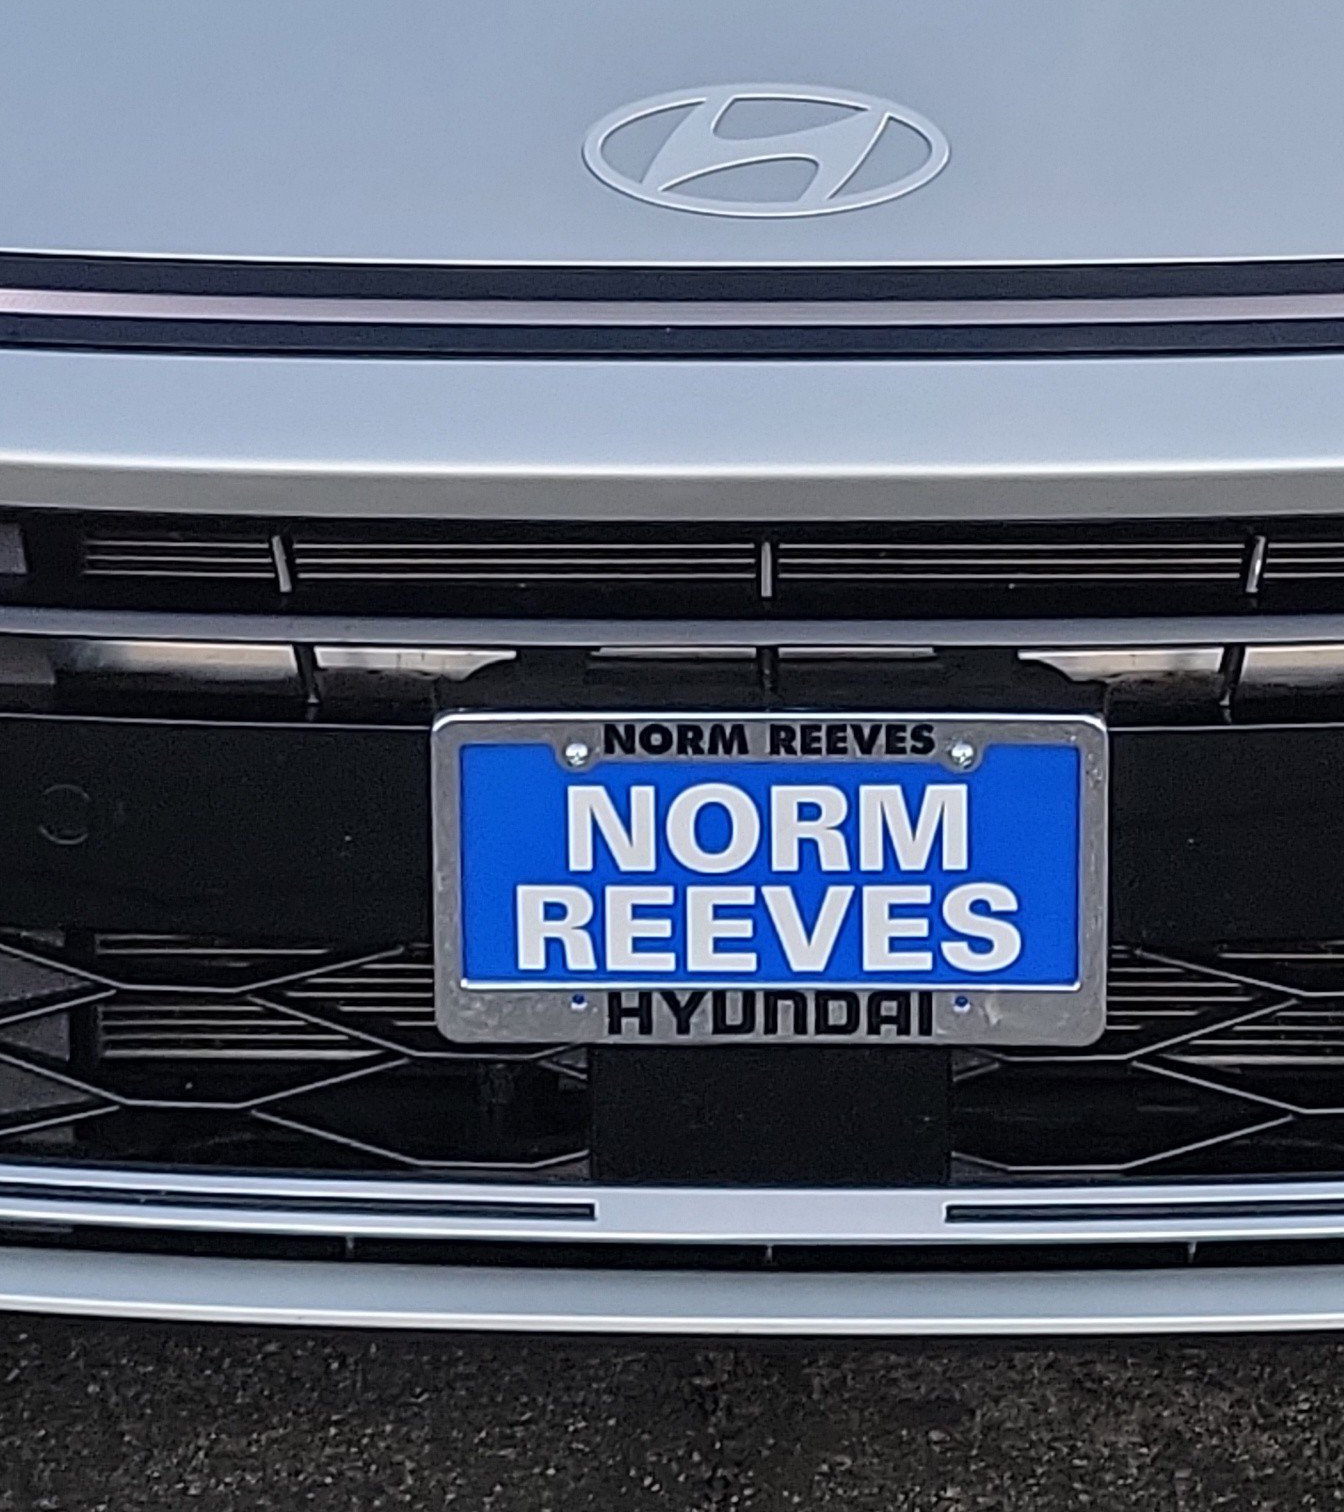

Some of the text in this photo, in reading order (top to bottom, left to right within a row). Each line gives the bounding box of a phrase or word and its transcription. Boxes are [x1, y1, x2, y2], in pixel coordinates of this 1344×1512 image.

[603, 723, 937, 755] NORM REEVES
[567, 783, 970, 874] NORM
[516, 881, 1022, 973] REEVES
[608, 990, 934, 1037] HYUNDAI
